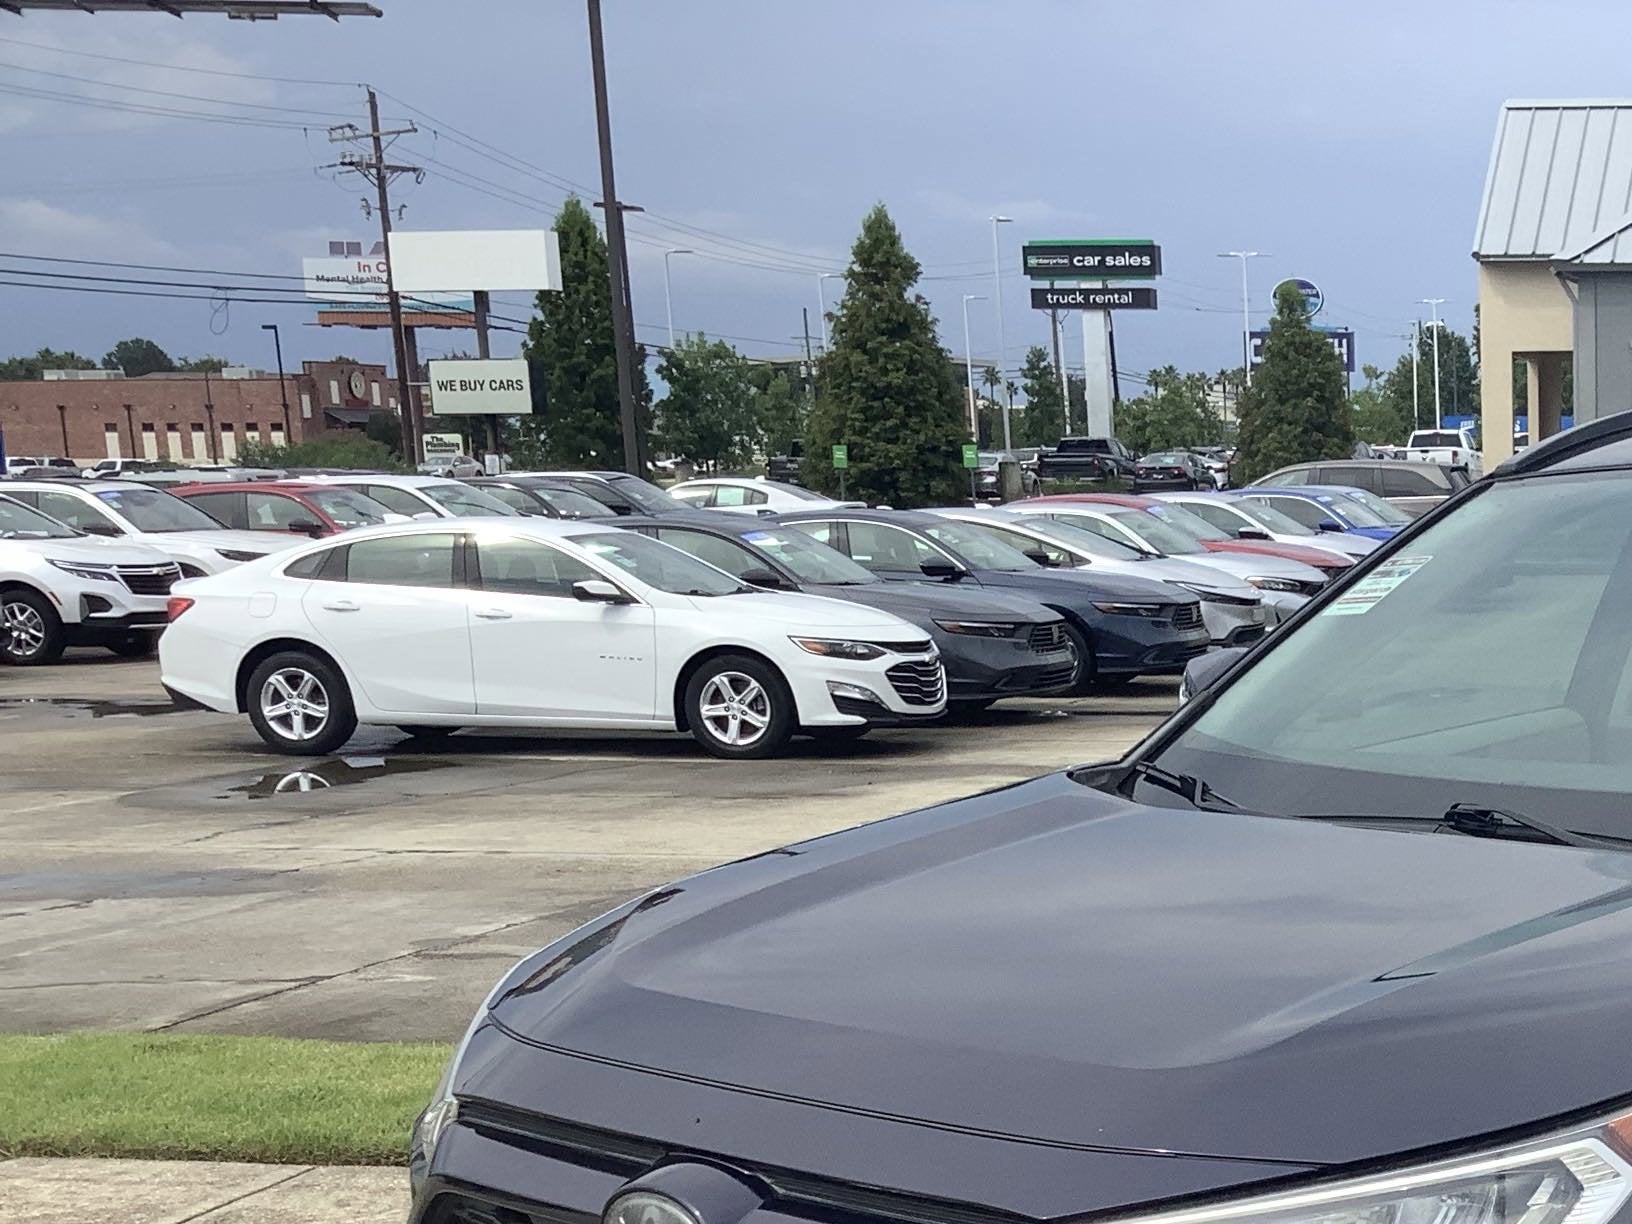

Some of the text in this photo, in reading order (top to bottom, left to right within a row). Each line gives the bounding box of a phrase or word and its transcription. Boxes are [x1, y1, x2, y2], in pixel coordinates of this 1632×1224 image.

[1073, 255, 1102, 266] car
[1105, 252, 1151, 266] sales
[357, 261, 372, 273] In
[315, 274, 383, 283] Mental Health
[1046, 291, 1132, 304] truck rental
[436, 379, 524, 391] WE BUY CARS
